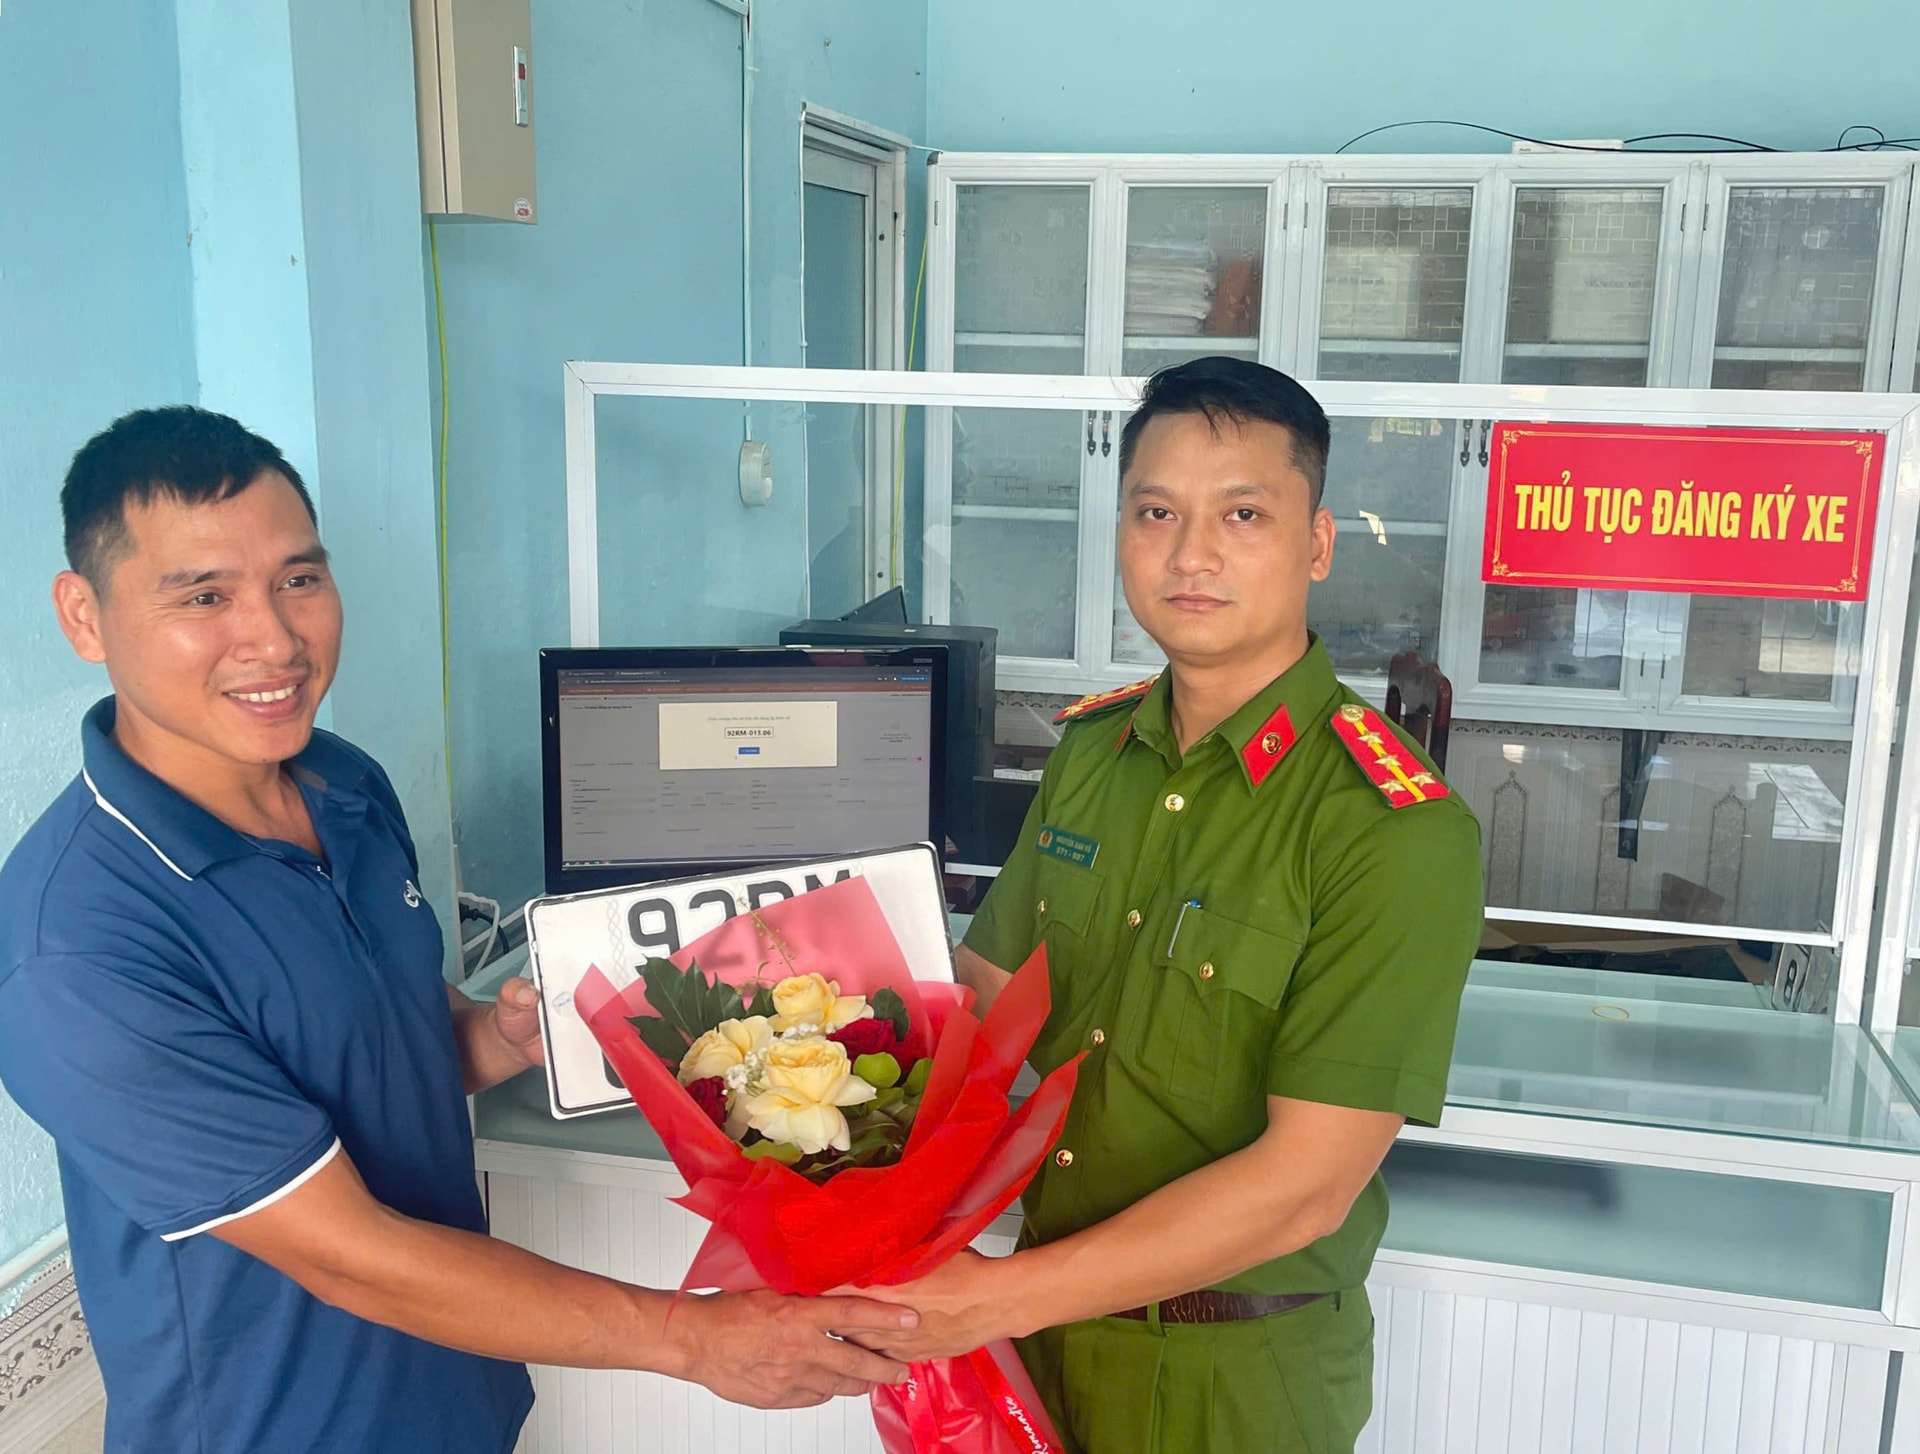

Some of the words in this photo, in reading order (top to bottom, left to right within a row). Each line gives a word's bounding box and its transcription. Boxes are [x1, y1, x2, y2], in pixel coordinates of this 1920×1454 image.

[1515, 470, 1574, 532] THỦ
[1584, 486, 1641, 544] TỤC
[1652, 480, 1741, 539] ĐĂNG
[1750, 484, 1796, 541] KÝ
[1802, 495, 1848, 543] XE
[726, 729, 772, 737] 92RM-013.06
